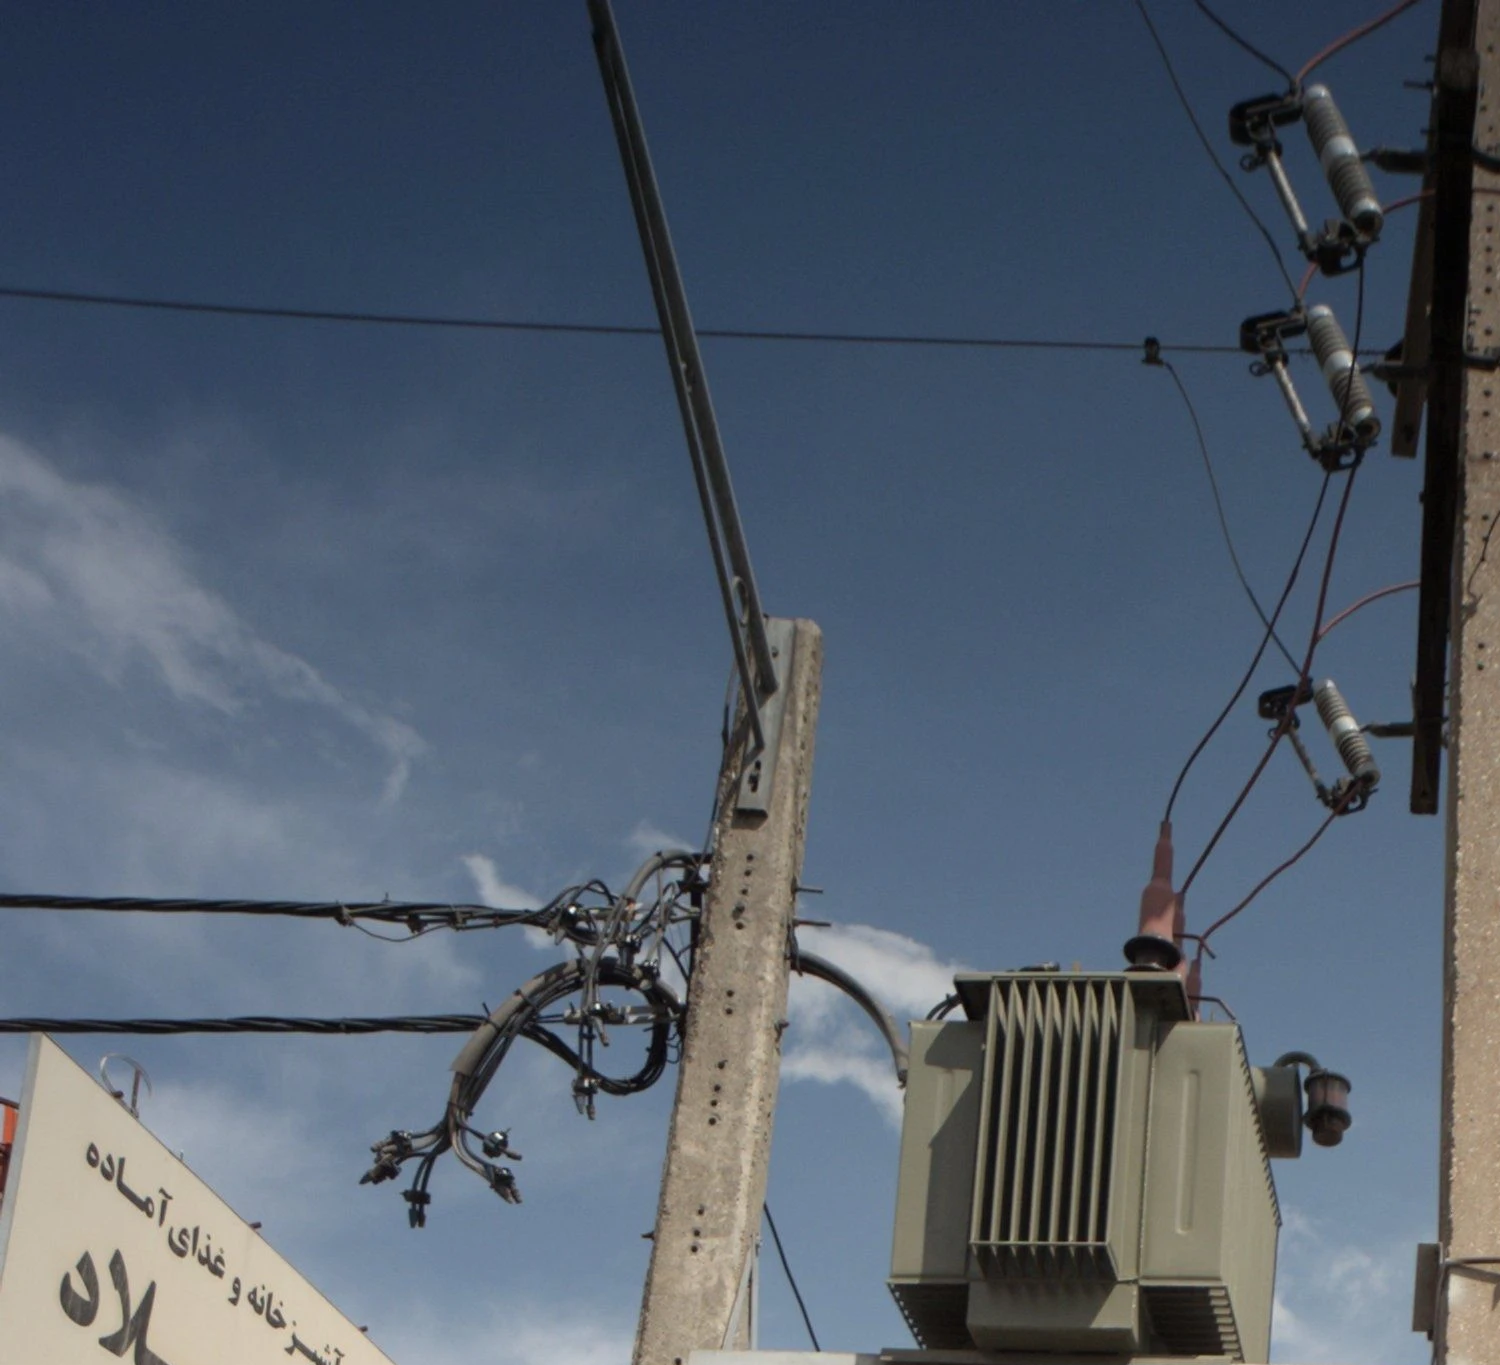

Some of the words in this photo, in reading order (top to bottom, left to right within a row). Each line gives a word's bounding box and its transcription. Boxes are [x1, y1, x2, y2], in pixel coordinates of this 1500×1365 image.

[85, 1141, 174, 1229] آماده
[167, 1224, 226, 1279] غذای
[227, 1276, 242, 1306] و
